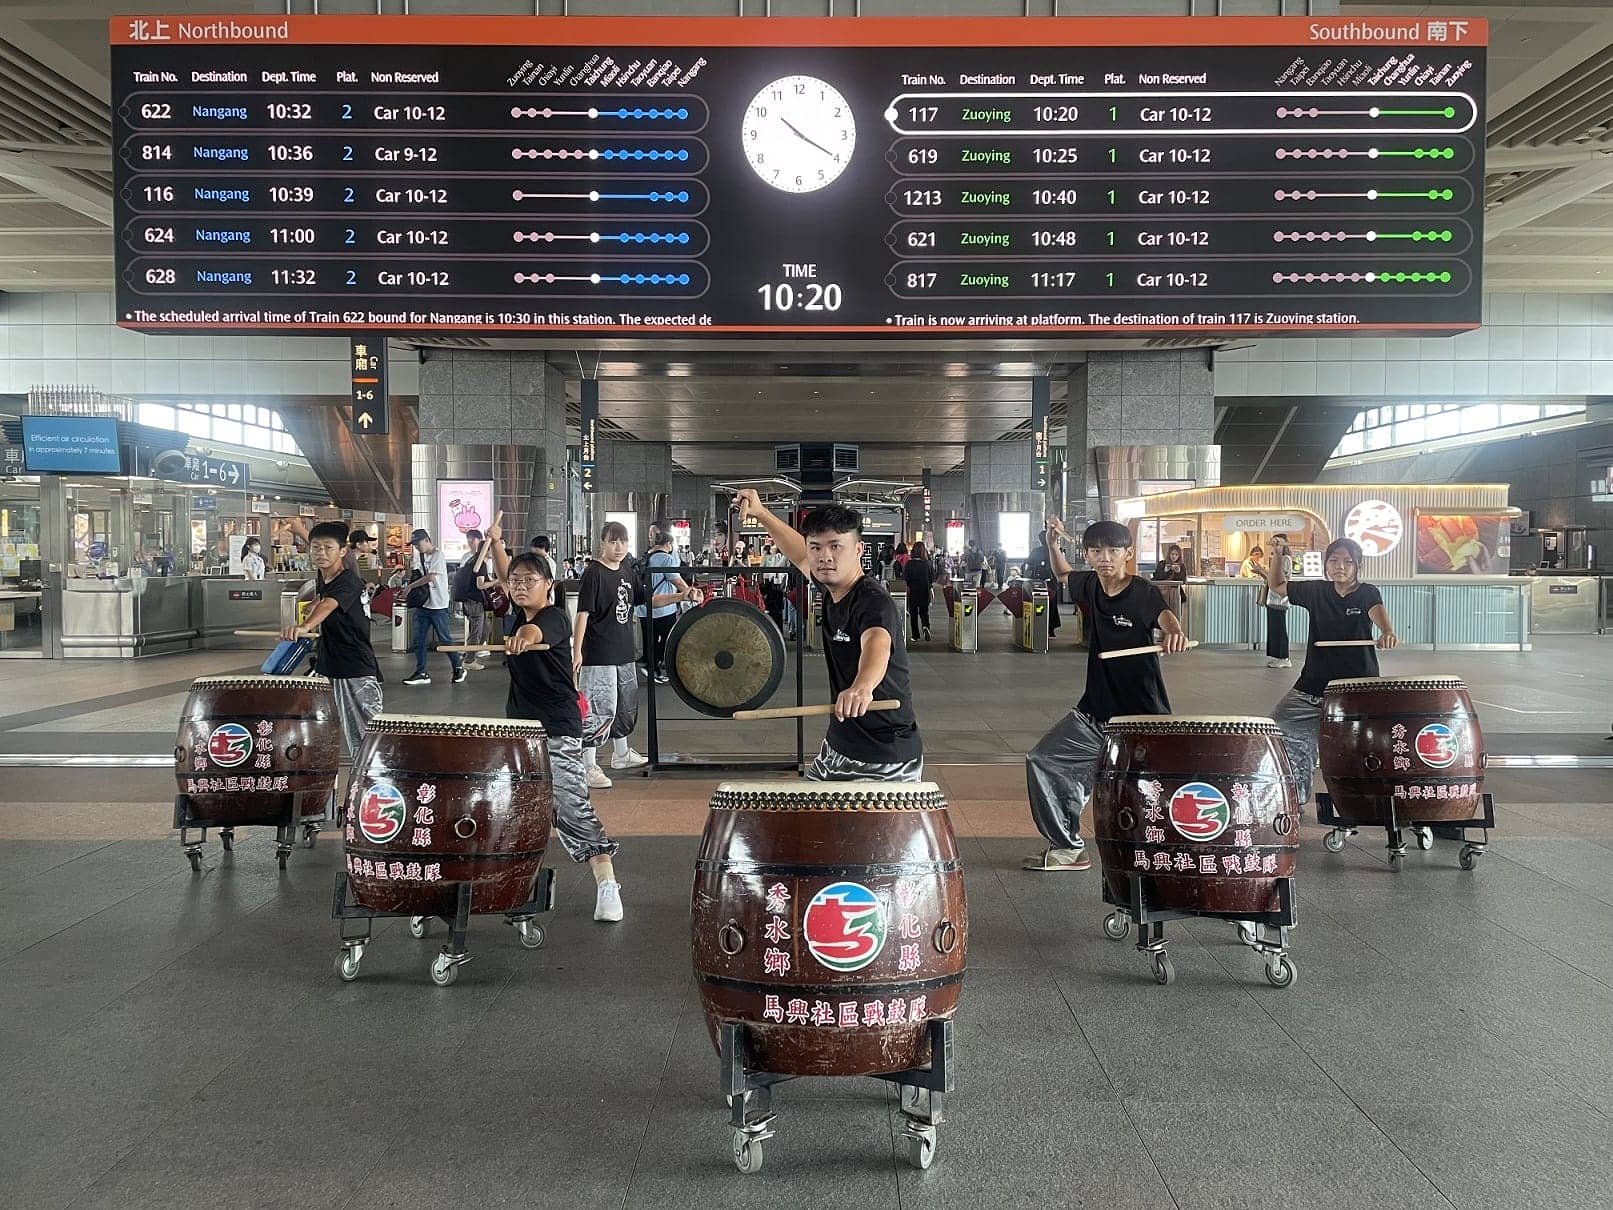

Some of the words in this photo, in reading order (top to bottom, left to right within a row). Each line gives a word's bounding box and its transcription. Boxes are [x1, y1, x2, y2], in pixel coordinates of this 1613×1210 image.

[129, 20, 170, 41] 北上
[179, 21, 288, 39] Northbound
[1310, 23, 1419, 40] Southbound
[1427, 21, 1469, 41] 南下
[133, 71, 160, 82] Train
[161, 72, 178, 82] No.
[191, 71, 247, 82] Destination
[262, 72, 288, 84] Dept.
[290, 71, 316, 82] Time
[336, 71, 358, 82] Plat.
[371, 72, 392, 82] Non
[395, 72, 438, 83] Reserved
[583, 56, 614, 86] Taichung
[616, 60, 641, 87] Hsinchu
[630, 59, 657, 87] Taoyuan
[646, 60, 673, 87] Banqiao
[677, 57, 707, 87] Nangang
[1367, 56, 1398, 86] Taichung
[1383, 54, 1415, 86] Changhua
[1429, 63, 1452, 86] Tainan
[1445, 60, 1473, 87] Zuoying
[901, 74, 927, 85] Train
[929, 75, 946, 85] No.
[960, 74, 1015, 85] Destination
[1030, 75, 1056, 86] Dept.
[1058, 74, 1084, 85] Time
[1104, 73, 1126, 84] Plat.
[1139, 74, 1160, 84] Non
[1163, 73, 1206, 84] Reserved
[772, 91, 782, 101] 11
[793, 84, 806, 94] 12
[141, 104, 172, 119] 622
[193, 106, 247, 119] Nangang
[266, 104, 312, 119] 10:32
[342, 105, 353, 119] 2
[374, 106, 399, 120] Car
[403, 107, 446, 120] 10-12
[754, 107, 767, 118] 10
[834, 107, 841, 118] 2
[908, 107, 938, 122] 117
[962, 108, 1011, 123] Zuoying
[1033, 107, 1078, 122] 10:20
[1140, 108, 1166, 122] Car
[1169, 107, 1212, 122] 10-12
[750, 130, 757, 140] 9
[841, 130, 848, 140] 3
[142, 146, 172, 160] 814
[193, 147, 248, 160] Nangang
[268, 146, 313, 160] 10:36
[343, 146, 353, 160] 2
[375, 148, 400, 161] Car
[404, 148, 438, 162] 9-12
[757, 153, 764, 164] 8
[908, 148, 938, 164] 619
[962, 150, 1010, 164] Zuoying
[1033, 148, 1078, 163] 10:25
[1140, 149, 1165, 163] Car
[1168, 149, 1211, 163] 10-12
[144, 187, 174, 202] 116
[195, 188, 249, 202] Nangang
[269, 187, 314, 202] 10:39
[344, 188, 354, 202] 2
[376, 189, 401, 203] Car
[405, 189, 447, 203] 10-12
[904, 190, 942, 206] 1213
[961, 191, 1010, 205] Zuoying
[1032, 190, 1077, 205] 10:40
[1139, 190, 1164, 204] Car
[1168, 190, 1210, 204] 10-12
[144, 228, 174, 242] 624
[196, 229, 250, 243] Nangang
[270, 229, 315, 243] 11:00
[345, 229, 356, 243] 2
[377, 231, 402, 244] Car
[406, 231, 448, 244] 10-12
[907, 232, 936, 247] 621
[961, 232, 1009, 246] Zuoying
[1032, 231, 1076, 246] 10:48
[1138, 232, 1163, 246] Car
[1167, 232, 1209, 246] 10-12
[146, 269, 176, 284] 628
[197, 271, 252, 284] Nangang
[271, 270, 316, 285] 11:32
[346, 271, 356, 285] 2
[378, 272, 402, 285] Car
[407, 272, 449, 286] 10-12
[783, 264, 817, 278] TIME
[907, 273, 937, 288] 817
[960, 274, 1009, 288] Zuoying
[1031, 273, 1076, 287] 11:17
[1137, 273, 1162, 287] Car
[1167, 273, 1208, 287] 10-12
[758, 284, 842, 311] 10:20
[134, 311, 157, 322] The
[159, 310, 218, 322] scheduled
[222, 310, 261, 323] arrival
[264, 311, 290, 322] time
[294, 311, 307, 322] of
[309, 312, 340, 323] Train
[342, 312, 365, 324] 622
[369, 312, 406, 324] bound
[410, 312, 427, 324] for
[430, 313, 482, 324] Nangang
[498, 313, 530, 324] 10:30
[549, 313, 570, 324] this
[573, 314, 616, 325] station.
[619, 314, 641, 325] The
[644, 314, 696, 325] expected
[895, 315, 925, 325] Train
[941, 316, 966, 325] now
[968, 315, 1014, 325] arriving
[1016, 315, 1028, 325] at
[1031, 314, 1086, 325] platform.
[1089, 314, 1110, 324] The
[1113, 313, 1179, 325] destination
[1182, 313, 1195, 324] of
[1198, 314, 1226, 324] train
[1229, 313, 1251, 324] 117
[1266, 313, 1314, 324] Zuoying
[1317, 313, 1361, 324] station.
[354, 343, 368, 371] 車廂
[370, 356, 379, 370] Car
[356, 389, 374, 400] 1-6
[31, 434, 60, 443] Efficient
[70, 435, 110, 444] circulation
[5, 448, 24, 463] 車
[88, 447, 115, 455] minutes
[5, 465, 22, 474] Car
[202, 460, 227, 482] 1-6
[584, 468, 592, 478] 2
[1236, 520, 1266, 528] ORDER
[1271, 519, 1293, 527] HERE
[255, 719, 274, 770] 彰化縣
[1391, 723, 1411, 771] 秀水鄉
[187, 775, 289, 794] 馬興社區戰鼓隊
[411, 783, 437, 847] 彰化縣
[1145, 779, 1165, 845] 秀水鄉
[1230, 782, 1253, 849] 彰化縣
[1133, 850, 1278, 876] 馬興社區戰鼓隊
[764, 881, 792, 977] 秀水鄉
[895, 881, 928, 972] 彰化縣
[763, 995, 929, 1028] 馬興社區戰鼓隊
